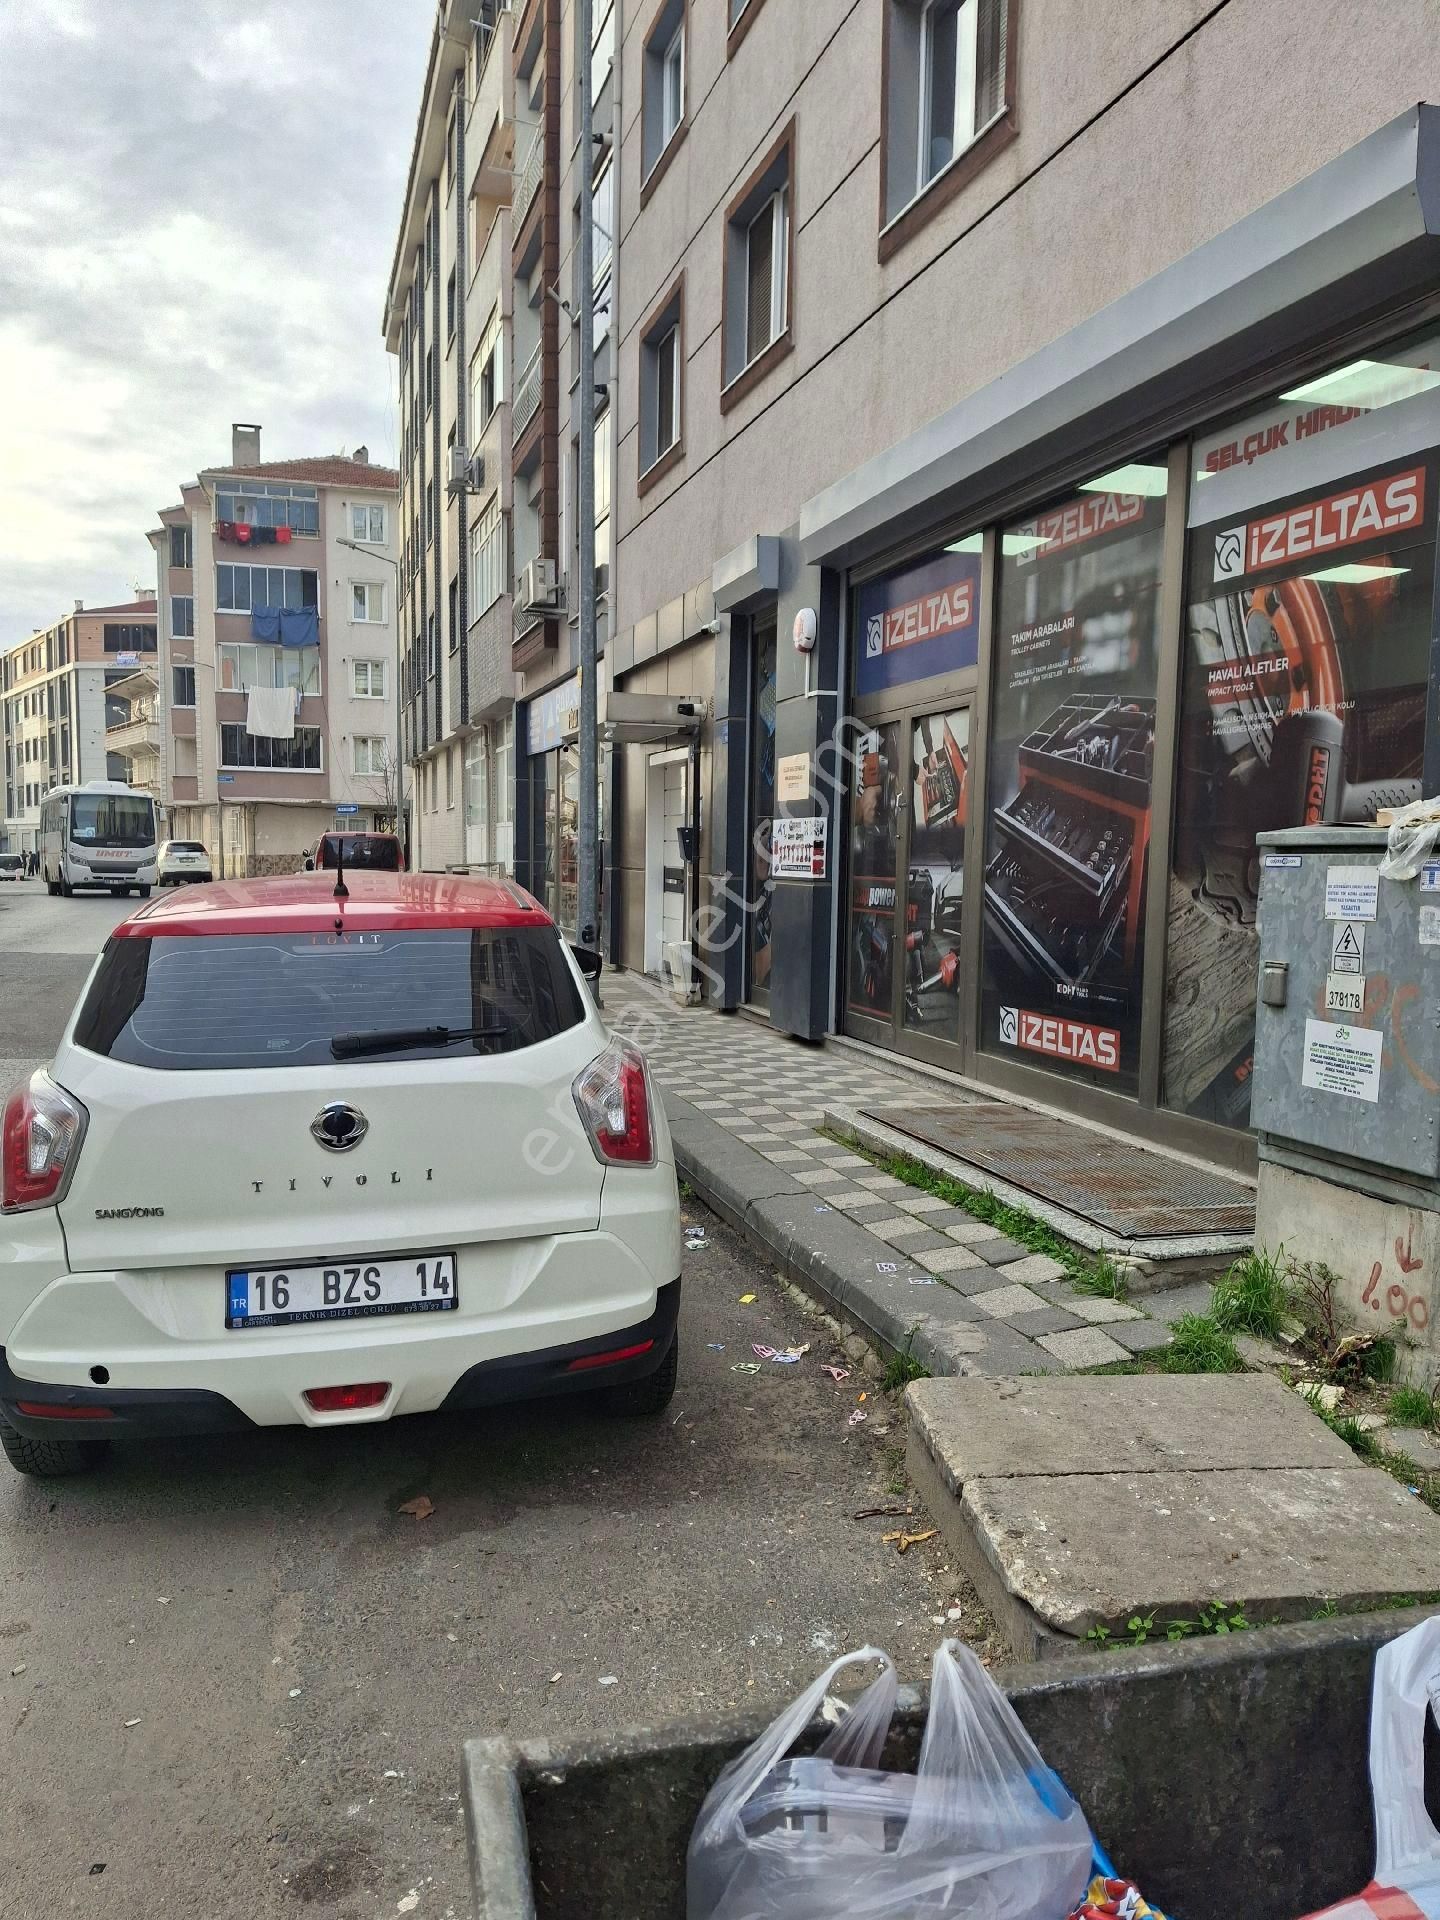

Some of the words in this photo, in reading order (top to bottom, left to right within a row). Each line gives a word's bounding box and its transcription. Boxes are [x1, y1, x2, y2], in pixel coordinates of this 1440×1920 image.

[1206, 420, 1289, 473] SELÇUK
[1011, 630, 1032, 645] TAKIM
[1033, 616, 1075, 639] ARABALARI
[1244, 657, 1289, 676] ALETLER
[1233, 682, 1254, 692] TOOLS
[1337, 701, 1355, 710] KOLU
[1329, 990, 1360, 1009] 378178
[252, 1168, 432, 1193] TIVOLI
[231, 1298, 247, 1310] TR
[255, 1274, 290, 1311] 16
[323, 1266, 381, 1306] BZS
[416, 1261, 450, 1297] 14
